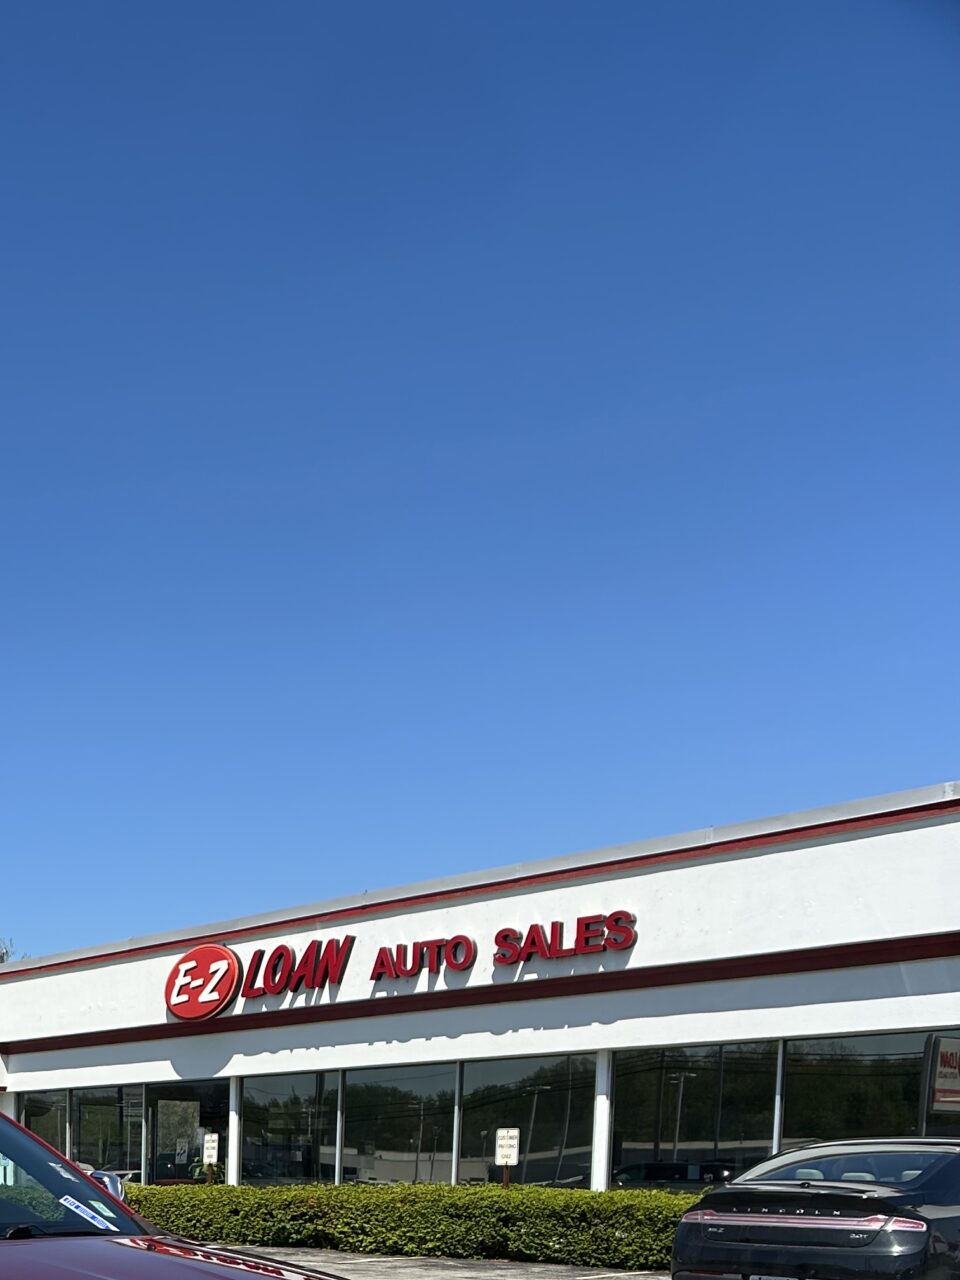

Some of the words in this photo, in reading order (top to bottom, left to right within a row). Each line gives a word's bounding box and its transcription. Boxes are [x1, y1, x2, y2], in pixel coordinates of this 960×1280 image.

[169, 958, 230, 1008] E-Z
[241, 934, 357, 998] LOAN
[370, 933, 478, 981] AUTO
[492, 909, 638, 966] SALES
